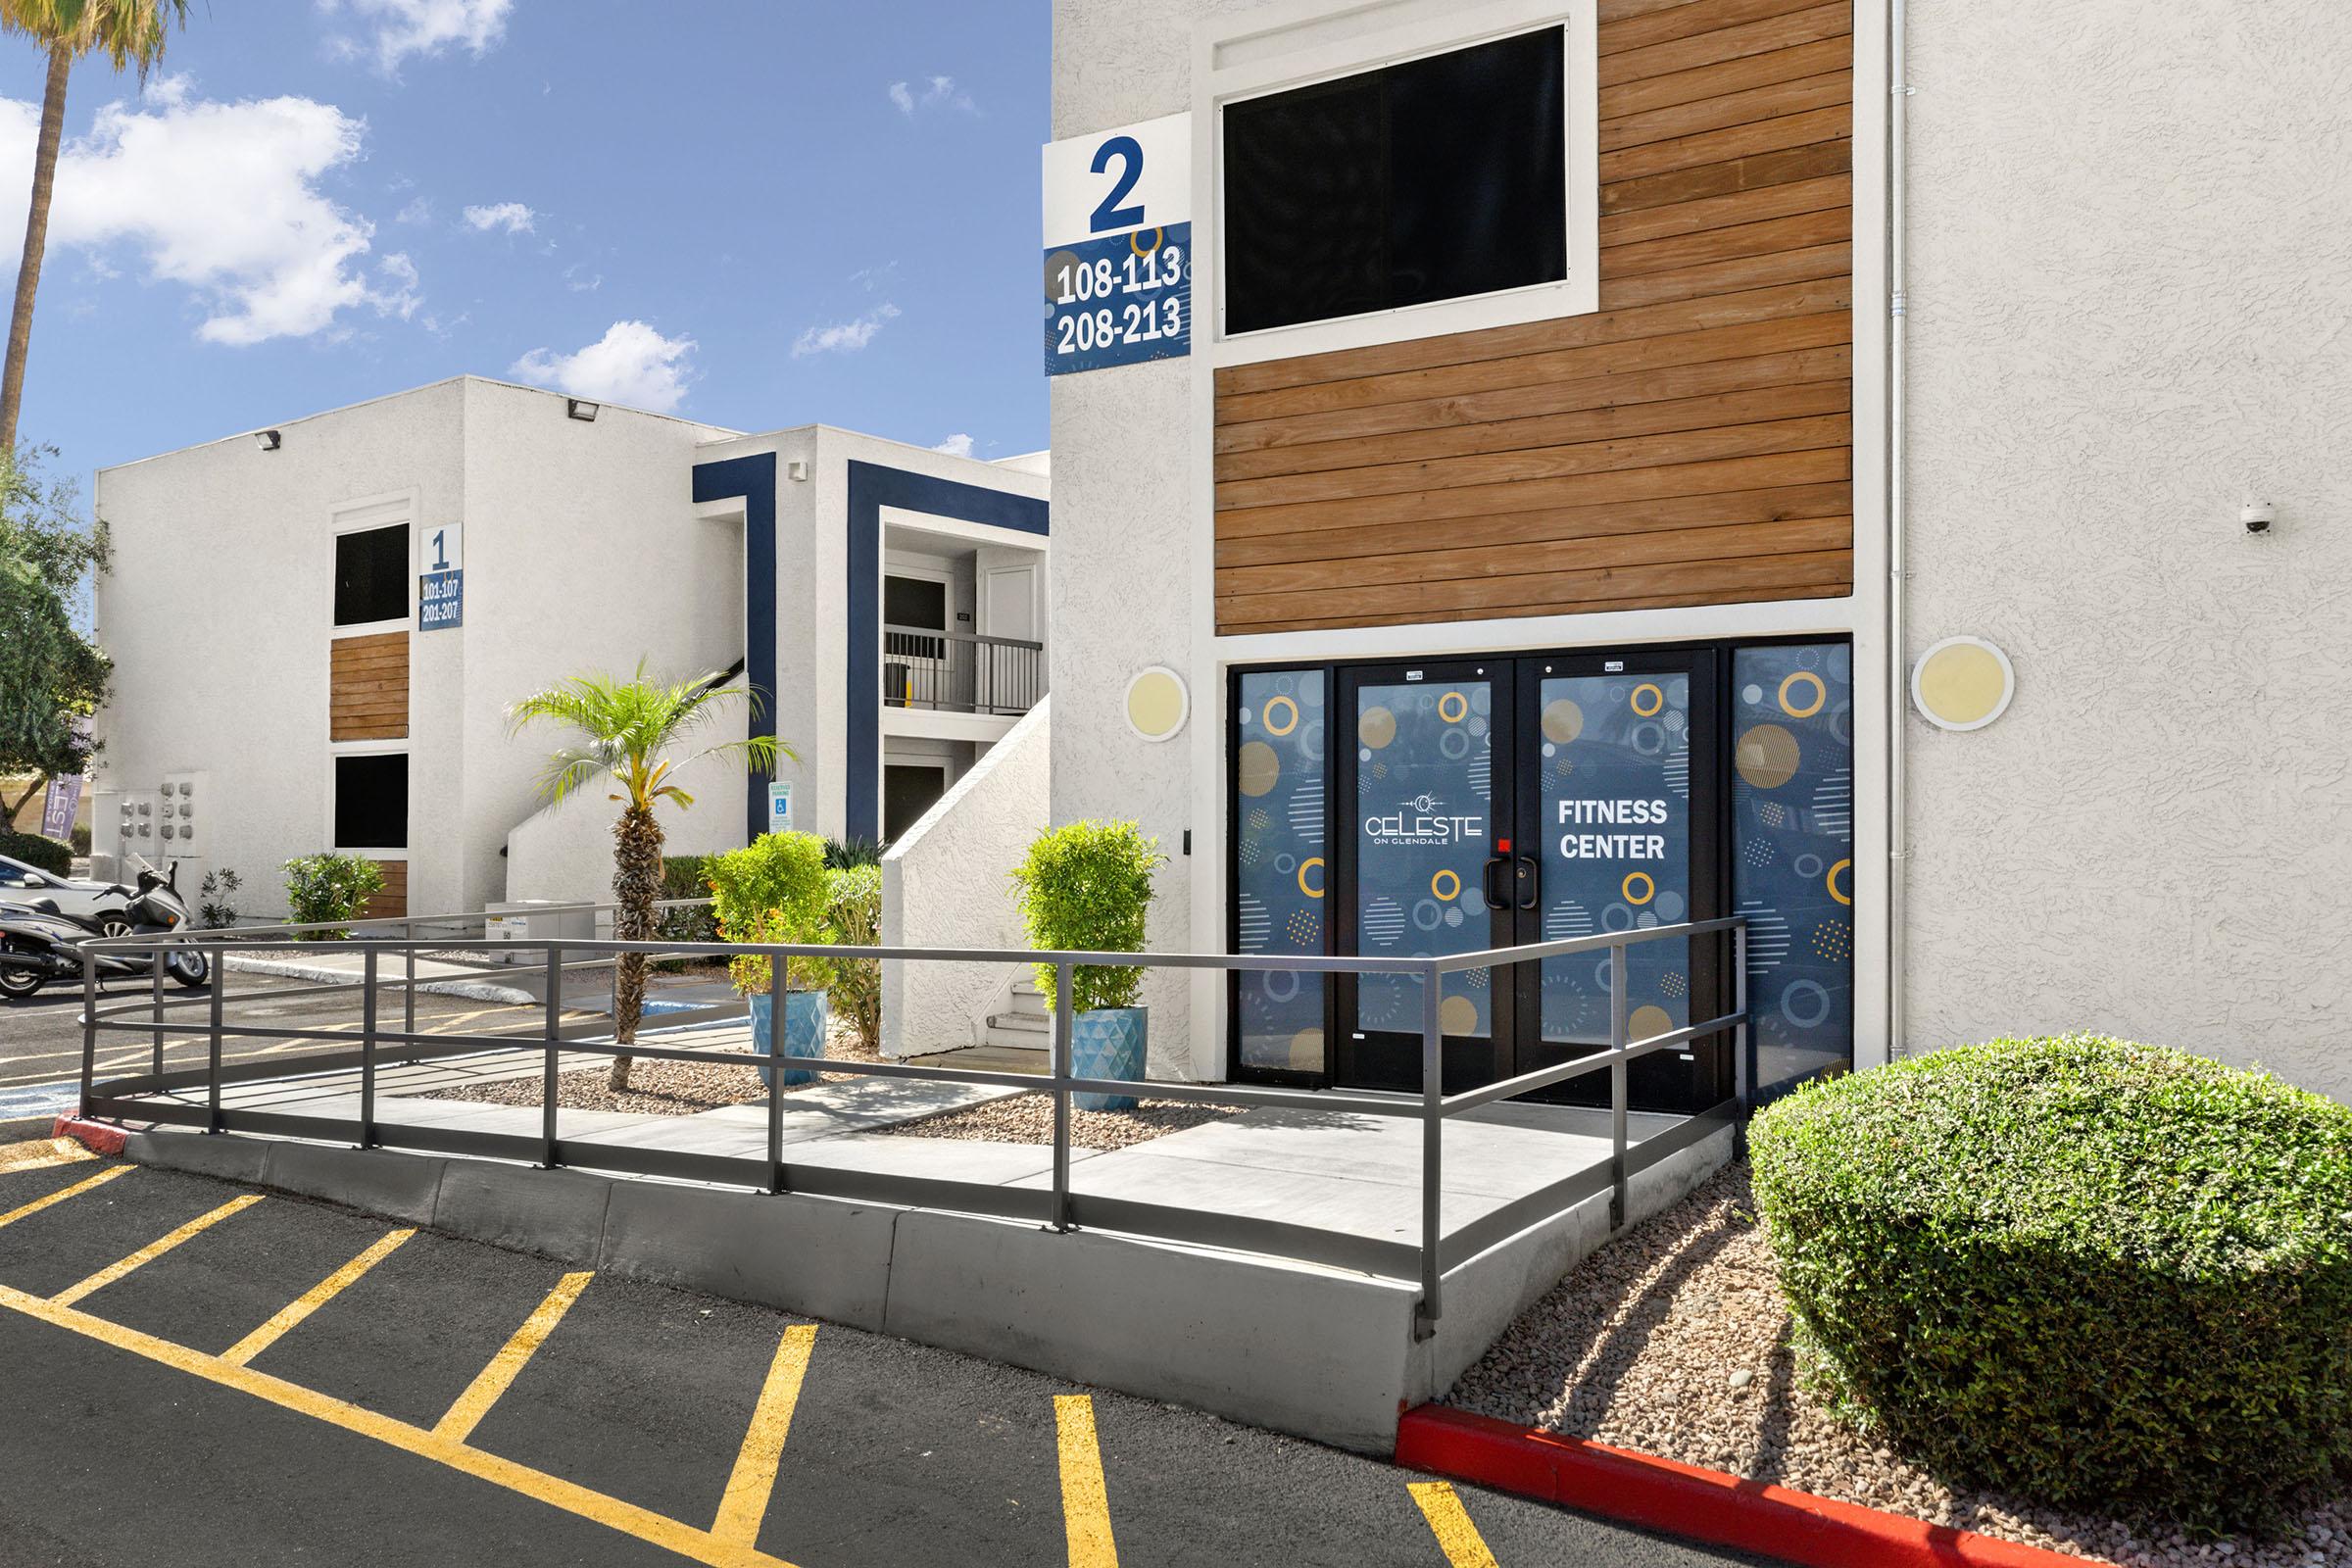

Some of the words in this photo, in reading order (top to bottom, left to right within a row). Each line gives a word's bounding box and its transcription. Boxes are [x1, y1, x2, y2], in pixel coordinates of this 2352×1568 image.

[1090, 135, 1146, 233] 2
[1057, 245, 1182, 305] 108-113
[1057, 297, 1182, 355] 208-213
[432, 529, 450, 570] 1
[422, 579, 459, 601] 101-107
[422, 601, 459, 622] 201-207
[1365, 811, 1483, 843] CELESTE
[1558, 799, 1668, 824] FITNESS
[1560, 834, 1665, 859] CENTER
